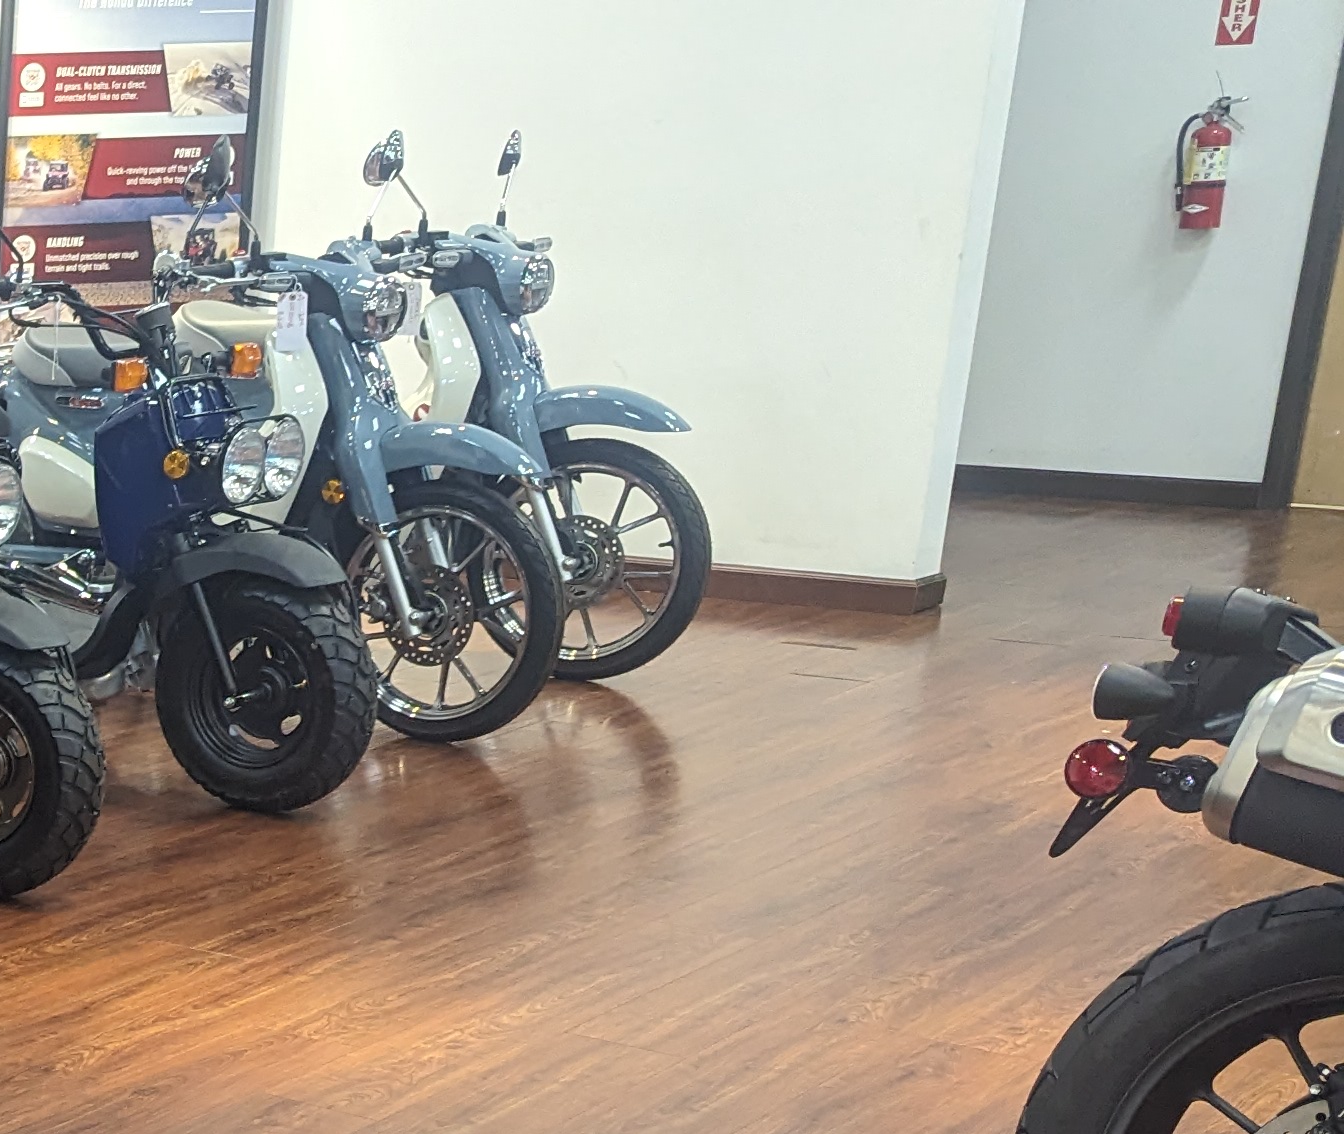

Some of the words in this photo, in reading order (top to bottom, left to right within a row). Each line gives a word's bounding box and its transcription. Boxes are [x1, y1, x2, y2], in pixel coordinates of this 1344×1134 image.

[55, 65, 106, 78] DUAL-CLUTCH
[107, 64, 162, 76] TRANSMISSION
[54, 94, 86, 102] connected
[87, 93, 99, 101] feel
[100, 92, 111, 101] like
[174, 147, 202, 158] POWER
[149, 166, 167, 175] power
[177, 164, 187, 173] the
[139, 176, 162, 186] through
[46, 235, 85, 248] HANDLING
